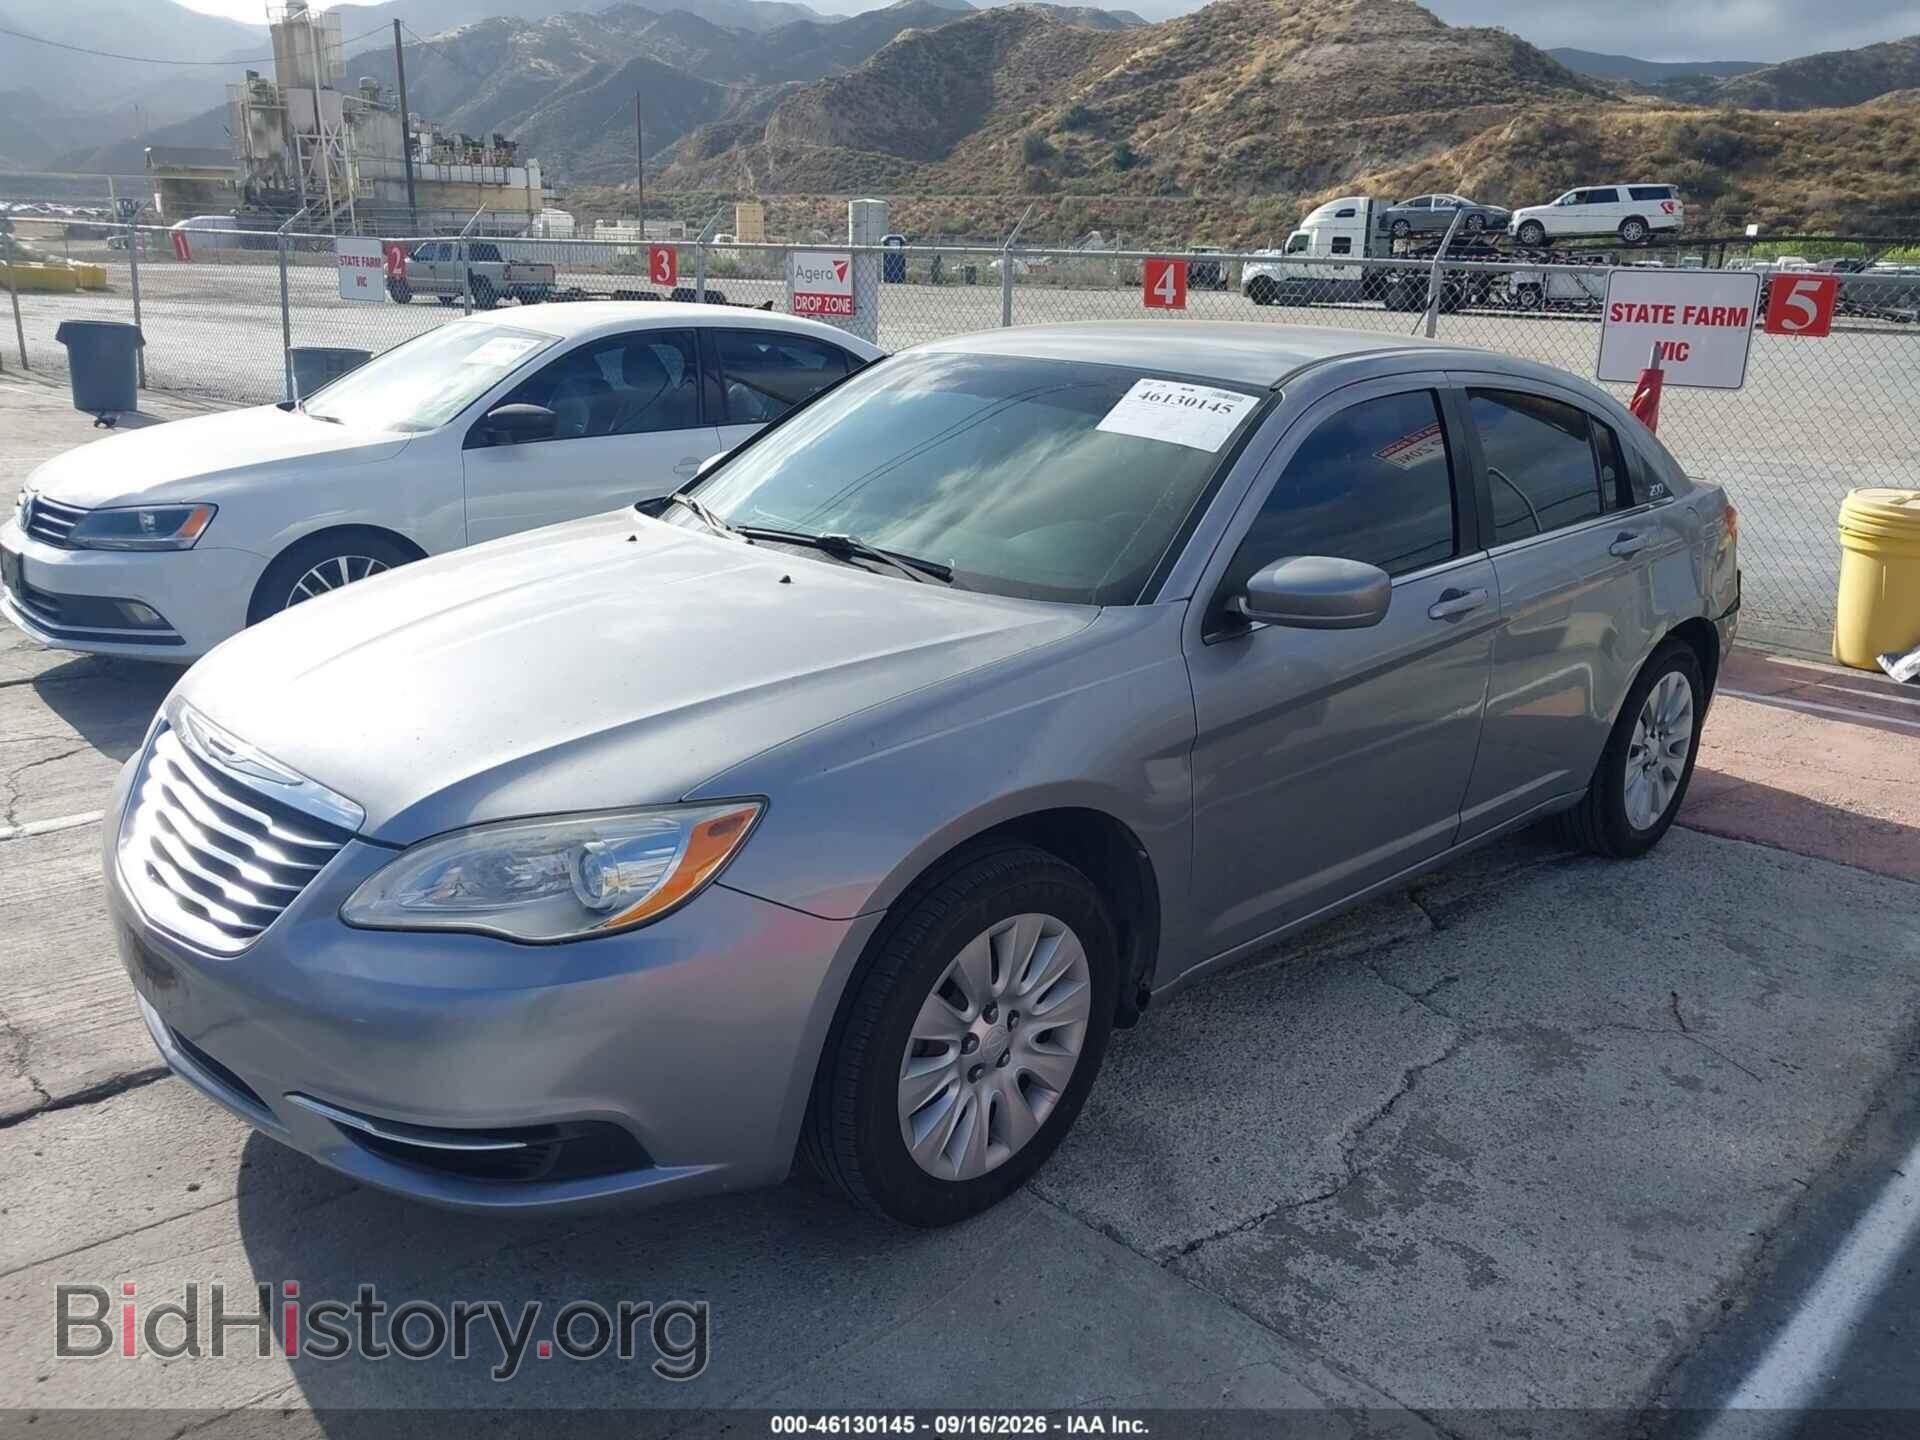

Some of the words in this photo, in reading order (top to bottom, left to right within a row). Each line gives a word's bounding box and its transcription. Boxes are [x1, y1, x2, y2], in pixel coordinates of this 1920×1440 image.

[340, 255, 360, 267] STATE
[361, 256, 382, 268] FARM
[391, 247, 402, 274] 2
[656, 250, 670, 281] 3
[795, 264, 833, 283] Agero
[1153, 263, 1177, 305] 4
[795, 295, 822, 311] DROP
[824, 297, 851, 313] ZONE
[1610, 303, 1675, 325] STATE
[1682, 305, 1749, 327] FARM
[1781, 280, 1822, 330] 5
[1655, 341, 1690, 362] VIC
[1138, 390, 1236, 415] 46130145
